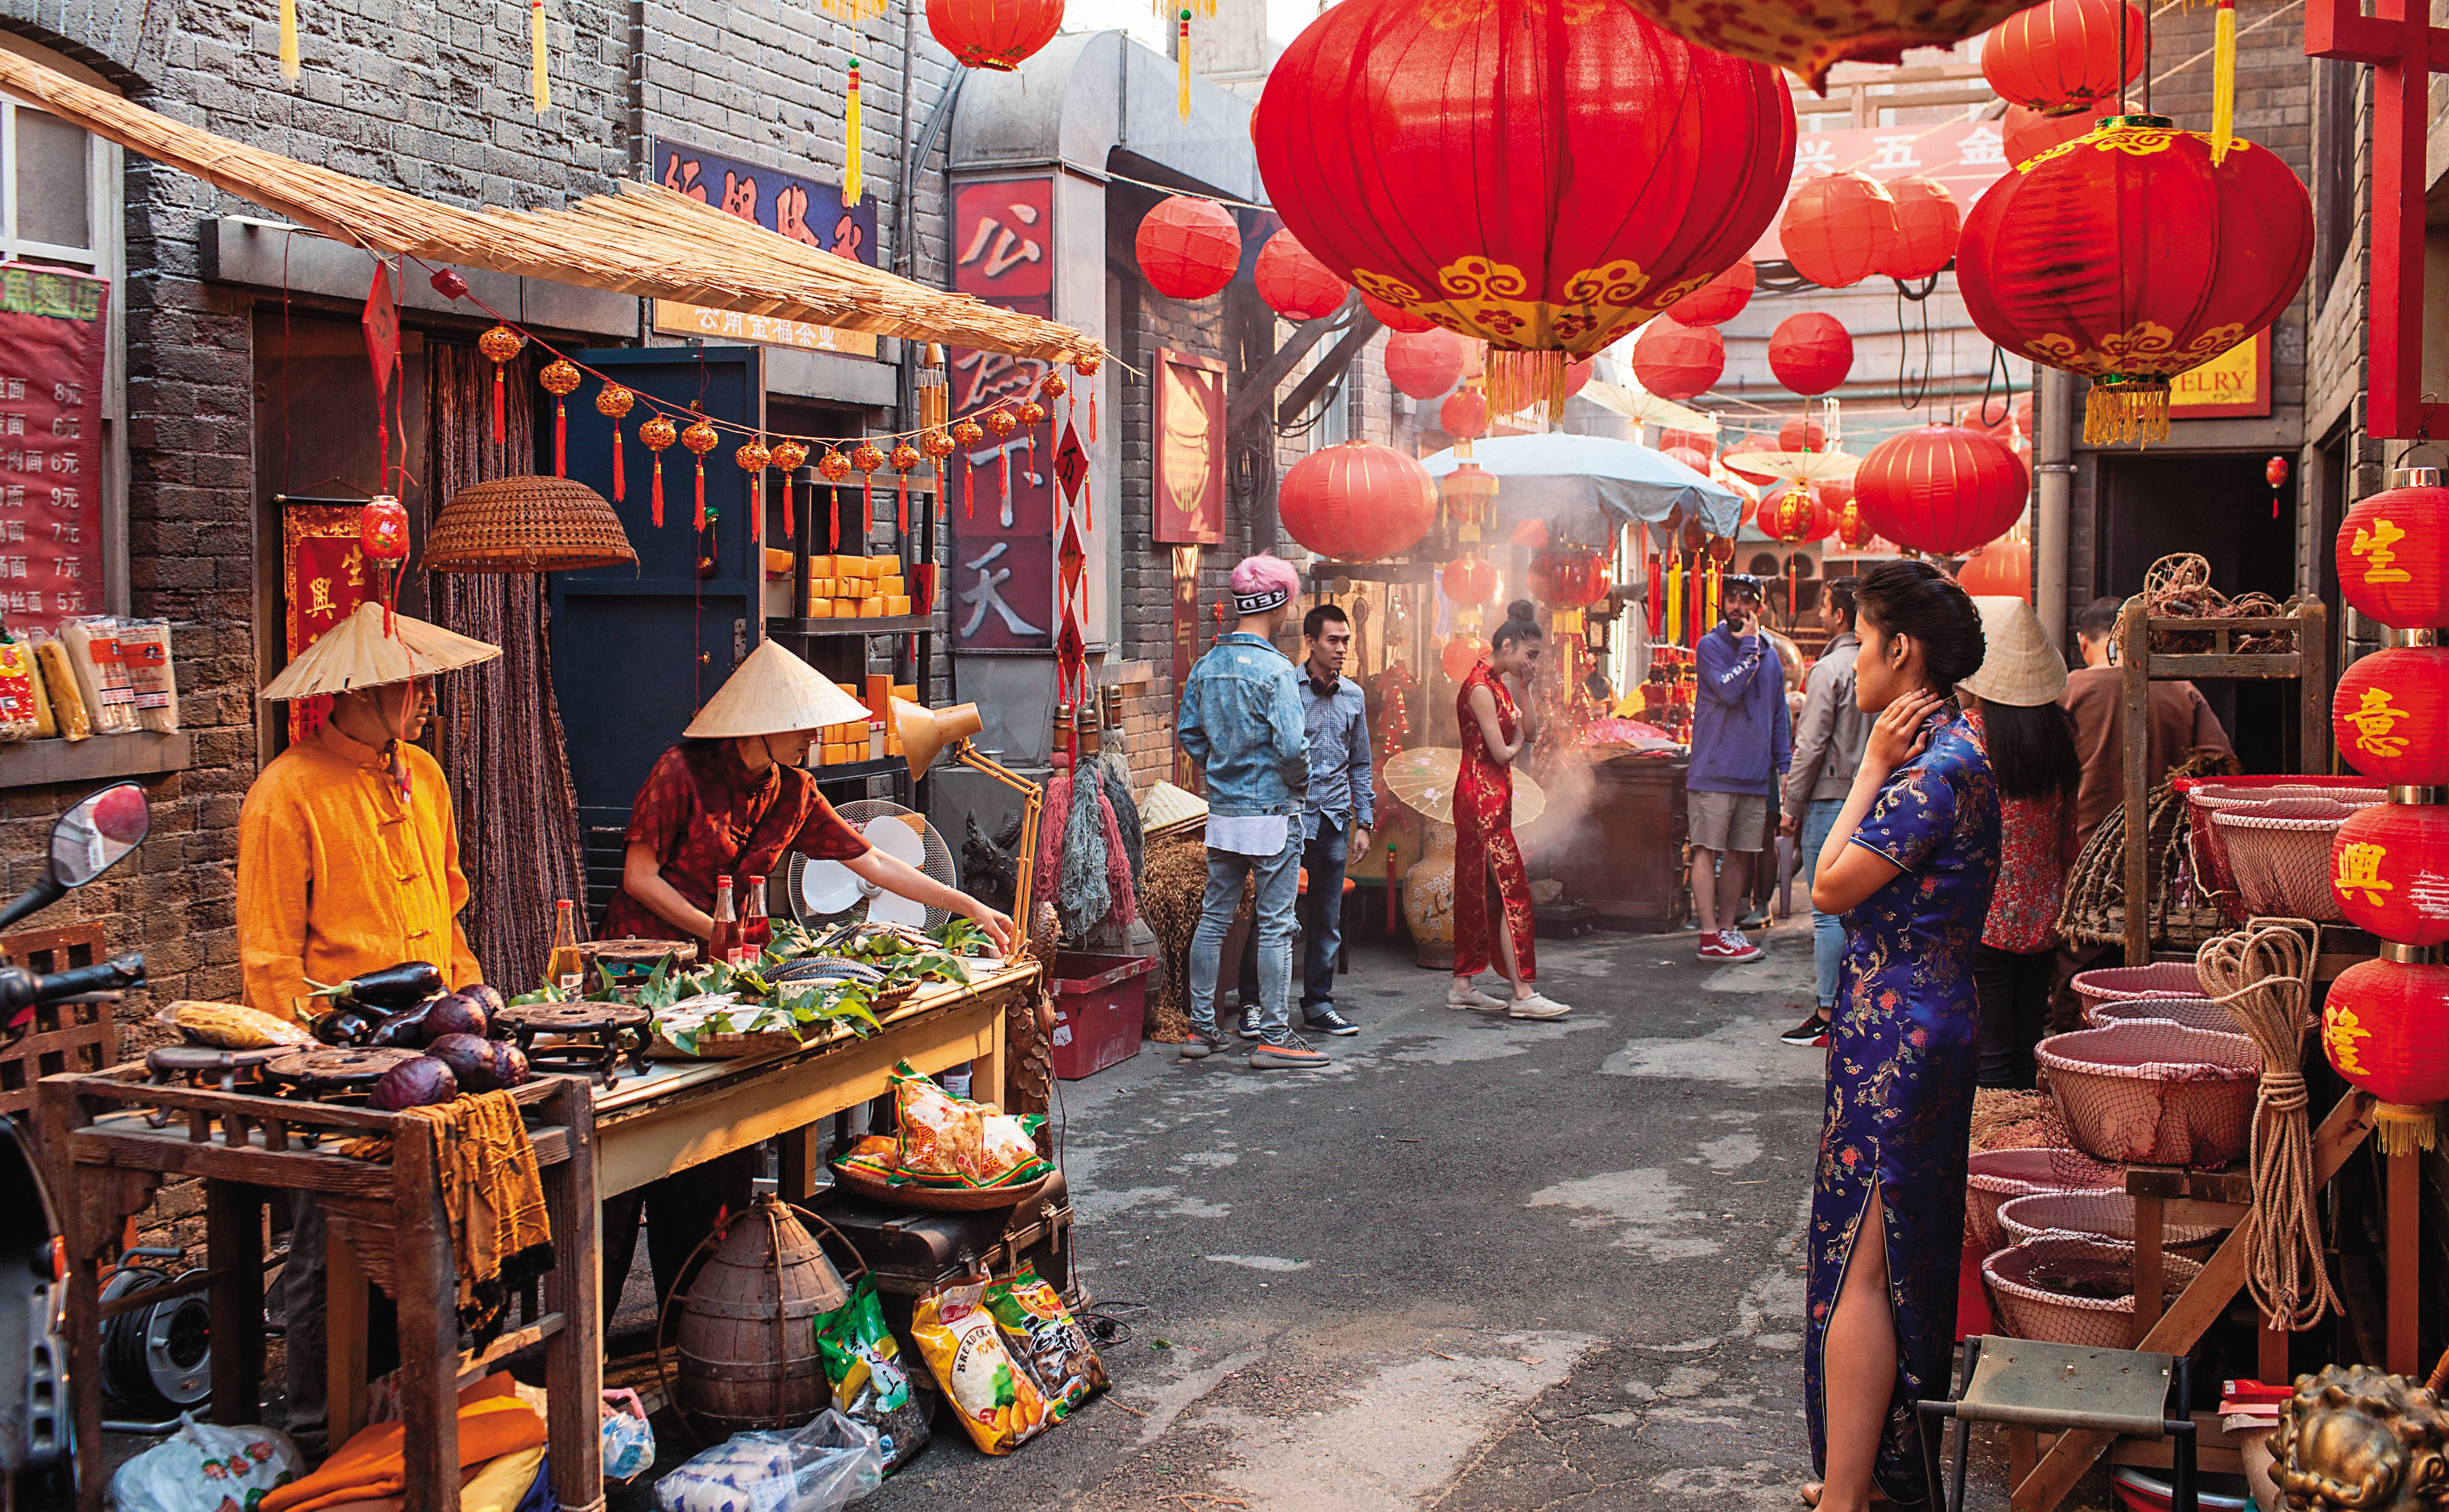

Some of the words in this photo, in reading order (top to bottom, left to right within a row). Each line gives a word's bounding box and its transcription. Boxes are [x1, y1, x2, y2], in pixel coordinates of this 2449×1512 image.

[2180, 370, 2249, 392] ELRY
[54, 383, 82, 405] 8元
[51, 418, 80, 439] 6元
[50, 452, 79, 474] 6元
[51, 486, 79, 509] 9元
[51, 522, 79, 543] 7元
[2350, 517, 2412, 584] 生
[53, 556, 81, 577] 7元
[56, 591, 86, 611] 5元
[2344, 687, 2410, 757] 意
[2334, 840, 2394, 907] 興
[2321, 1004, 2372, 1076] 隆
[957, 1334, 977, 1373] BREAD
